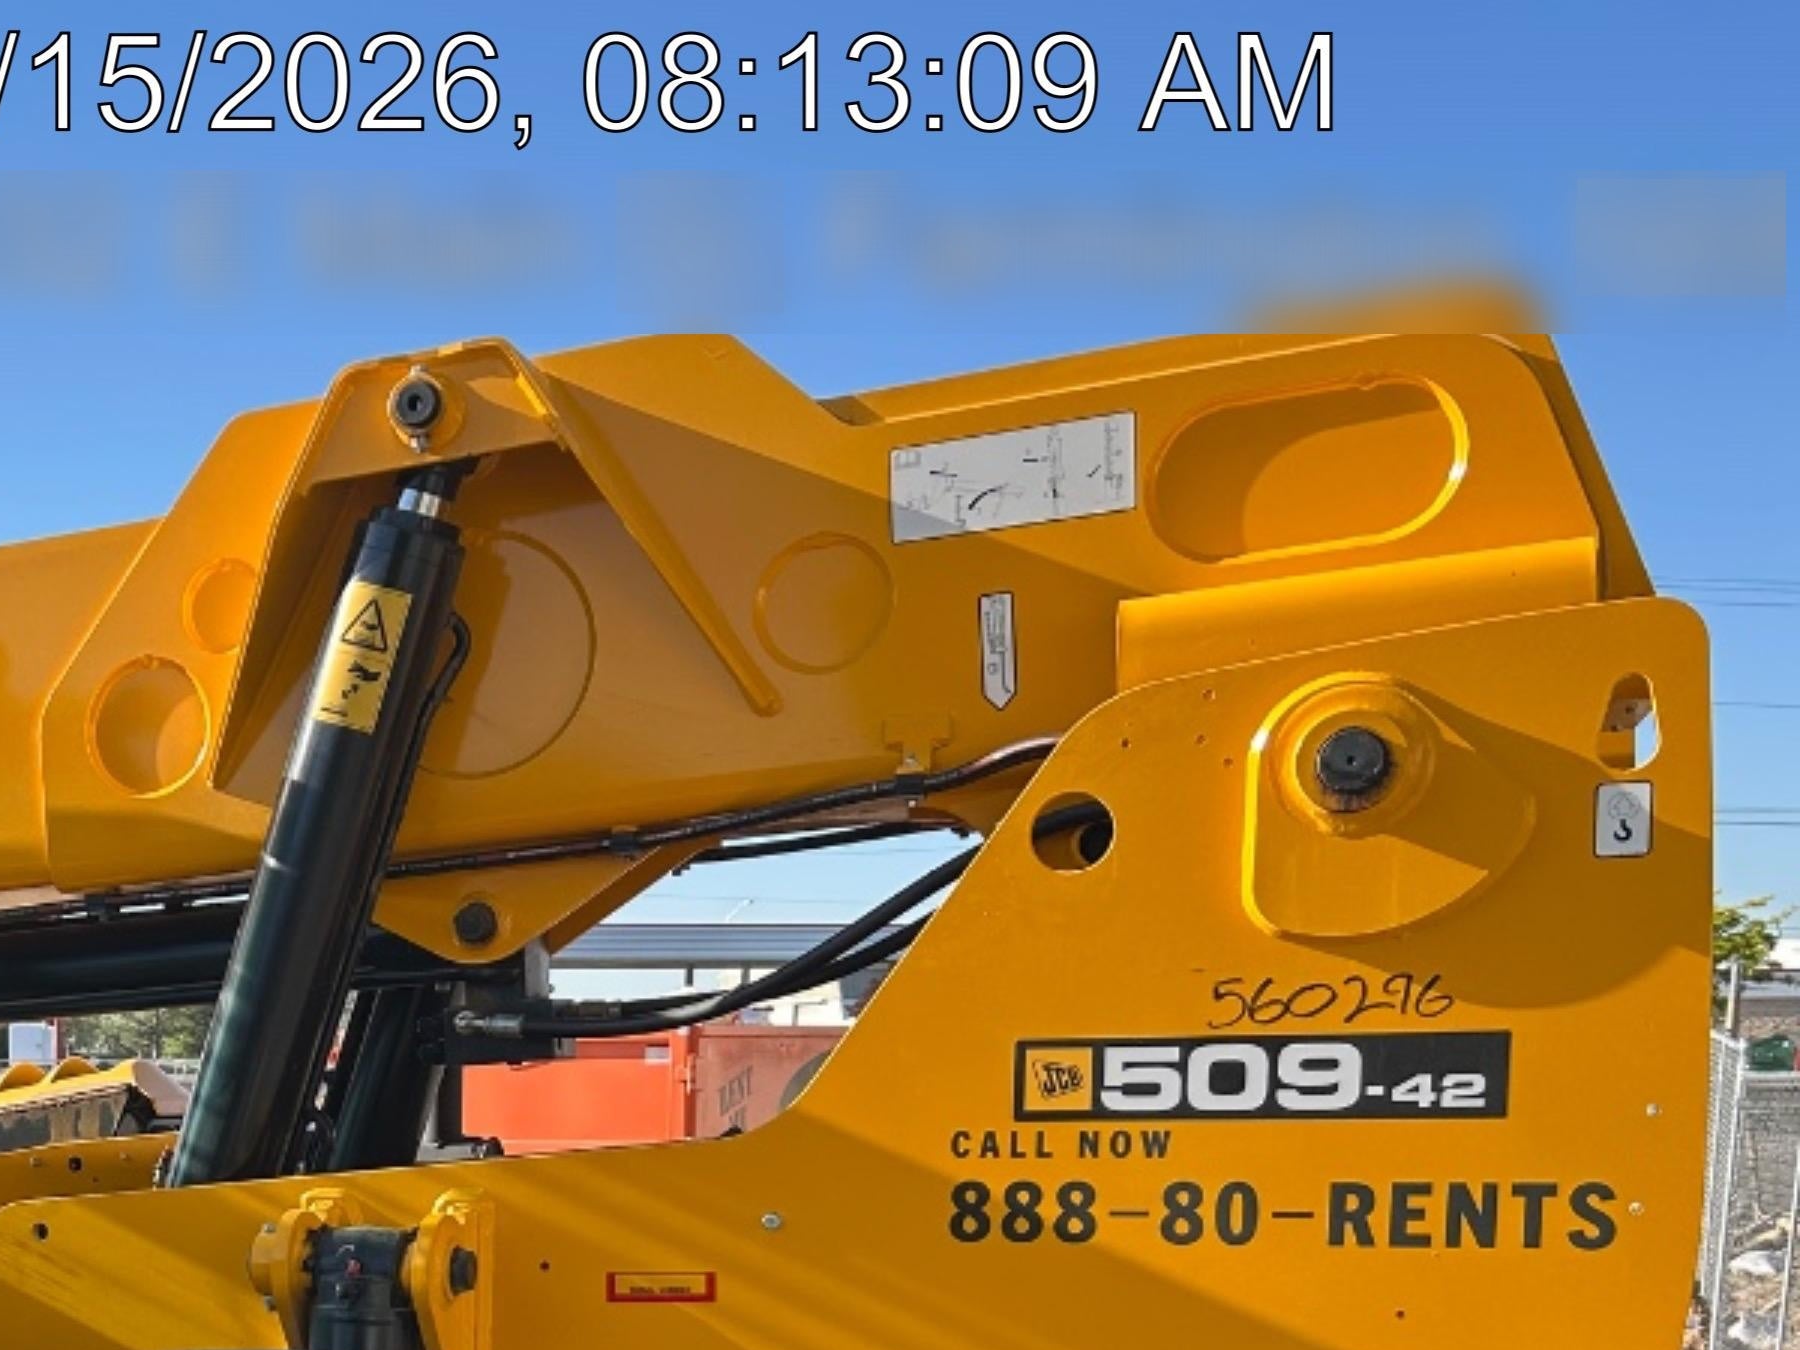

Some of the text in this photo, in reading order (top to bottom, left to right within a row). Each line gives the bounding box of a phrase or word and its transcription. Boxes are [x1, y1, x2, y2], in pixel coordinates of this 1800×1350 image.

[1208, 973, 1454, 1029] 560296
[950, 1130, 1172, 1160] CALL NOW
[949, 1180, 1619, 1250] 888-80-RENTS
